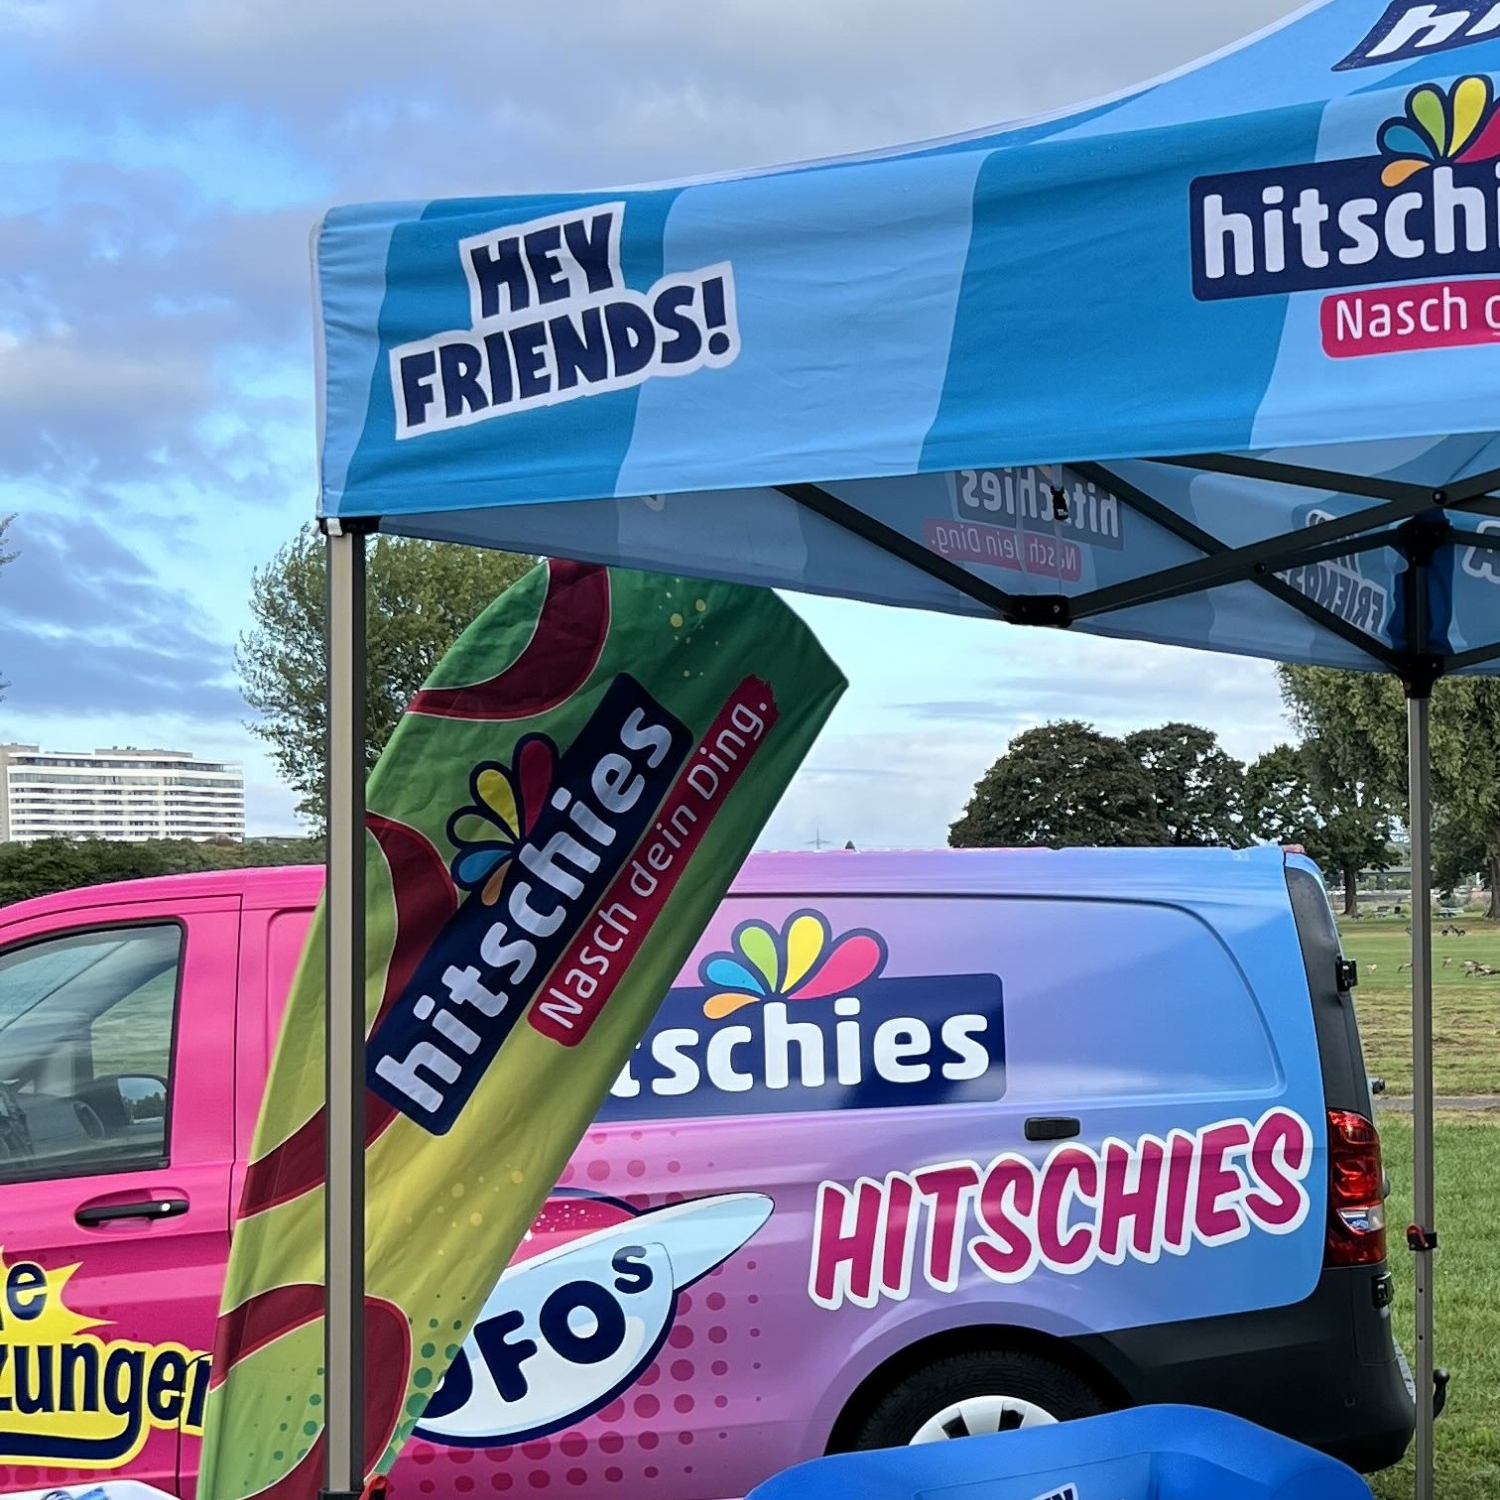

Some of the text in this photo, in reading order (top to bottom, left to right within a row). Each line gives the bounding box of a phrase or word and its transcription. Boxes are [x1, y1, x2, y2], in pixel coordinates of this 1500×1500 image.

[470, 212, 614, 318] HEY
[1336, 288, 1468, 341] Nasch
[399, 278, 731, 428] FRIENDS!
[375, 707, 672, 1112] hitschies
[539, 700, 767, 1029] Nasch dein Ding.
[814, 1117, 1307, 1303] HITSCHIES
